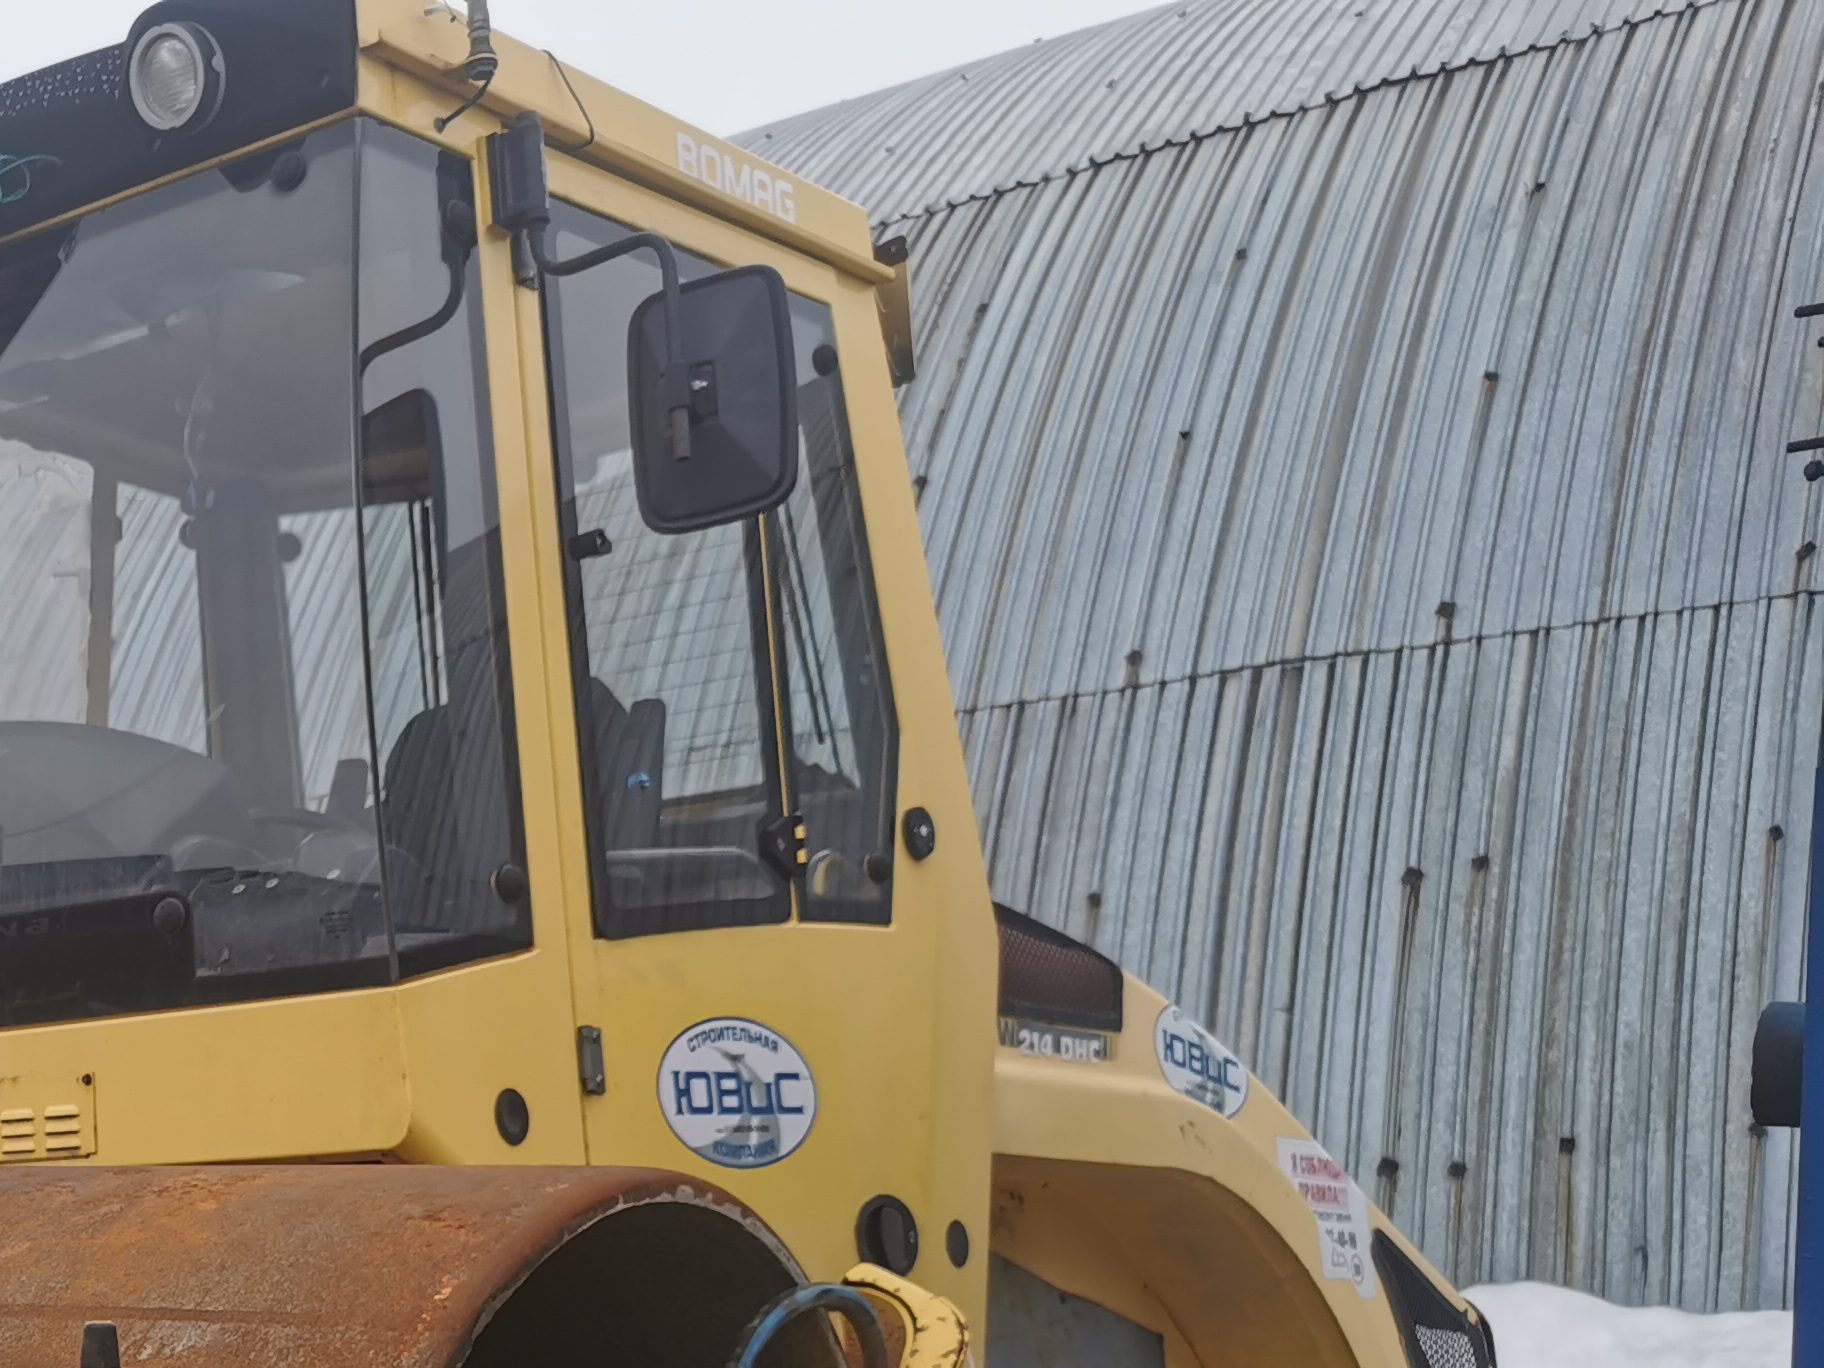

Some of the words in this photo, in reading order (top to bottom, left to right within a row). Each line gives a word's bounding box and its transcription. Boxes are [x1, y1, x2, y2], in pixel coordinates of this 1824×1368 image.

[677, 132, 795, 223] BOMAG
[687, 1026, 779, 1053] СТРОИТЕЛЬНАЯ
[1018, 1029, 1054, 1056] 214
